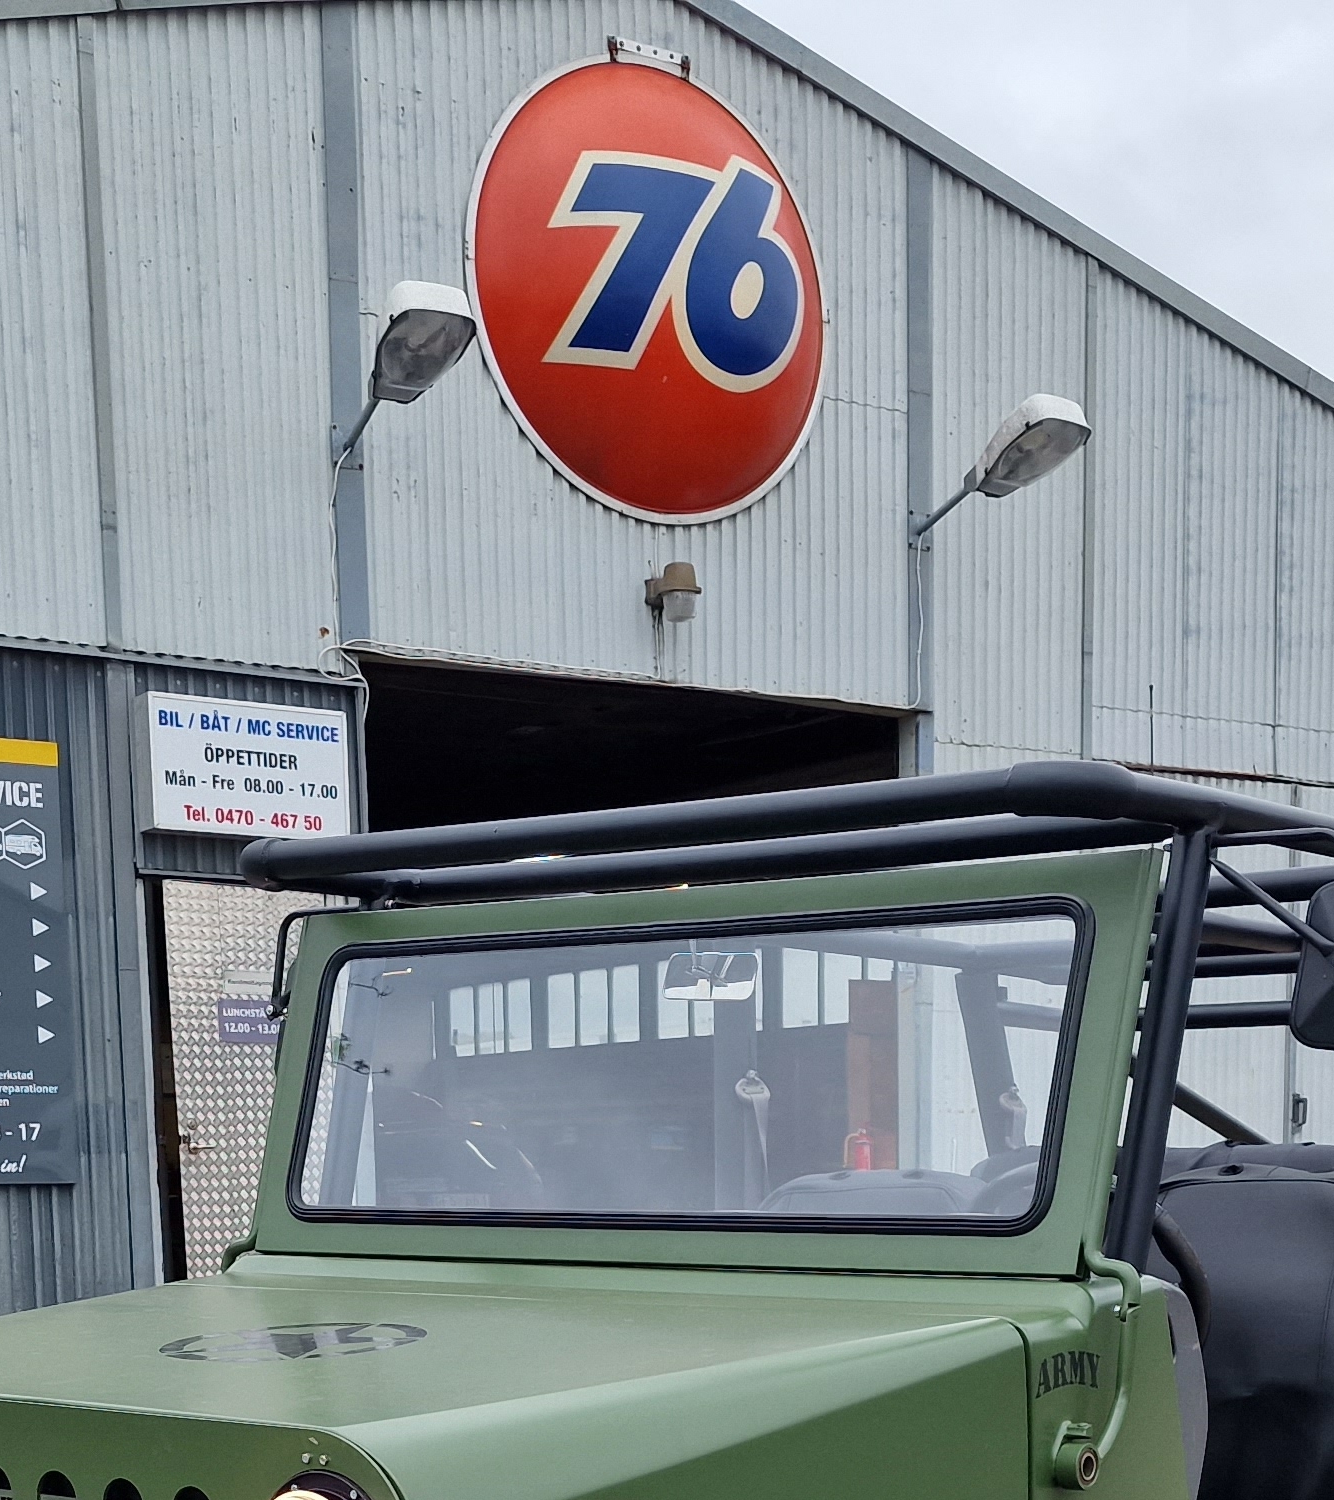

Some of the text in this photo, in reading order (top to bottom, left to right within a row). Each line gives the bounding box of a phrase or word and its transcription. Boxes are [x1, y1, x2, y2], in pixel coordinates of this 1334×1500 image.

[541, 150, 804, 393] 76
[158, 710, 183, 727] BIL
[200, 710, 230, 732] BÅT
[248, 719, 271, 737] MC
[276, 721, 339, 743] SERVICE
[204, 743, 298, 770] ÖPPETTIDER
[165, 769, 196, 787] Mån
[212, 774, 235, 790] Fre
[244, 777, 284, 795] 08.00
[299, 782, 338, 799] 17.00
[184, 805, 210, 822] Tel.
[215, 808, 254, 825] 0470
[271, 813, 298, 829] 467
[304, 816, 322, 831] 50
[224, 1022, 250, 1034] 12.00
[18, 1122, 41, 1141] 17
[0, 1154, 27, 1173] in!
[1035, 1350, 1100, 1399] ARMY
